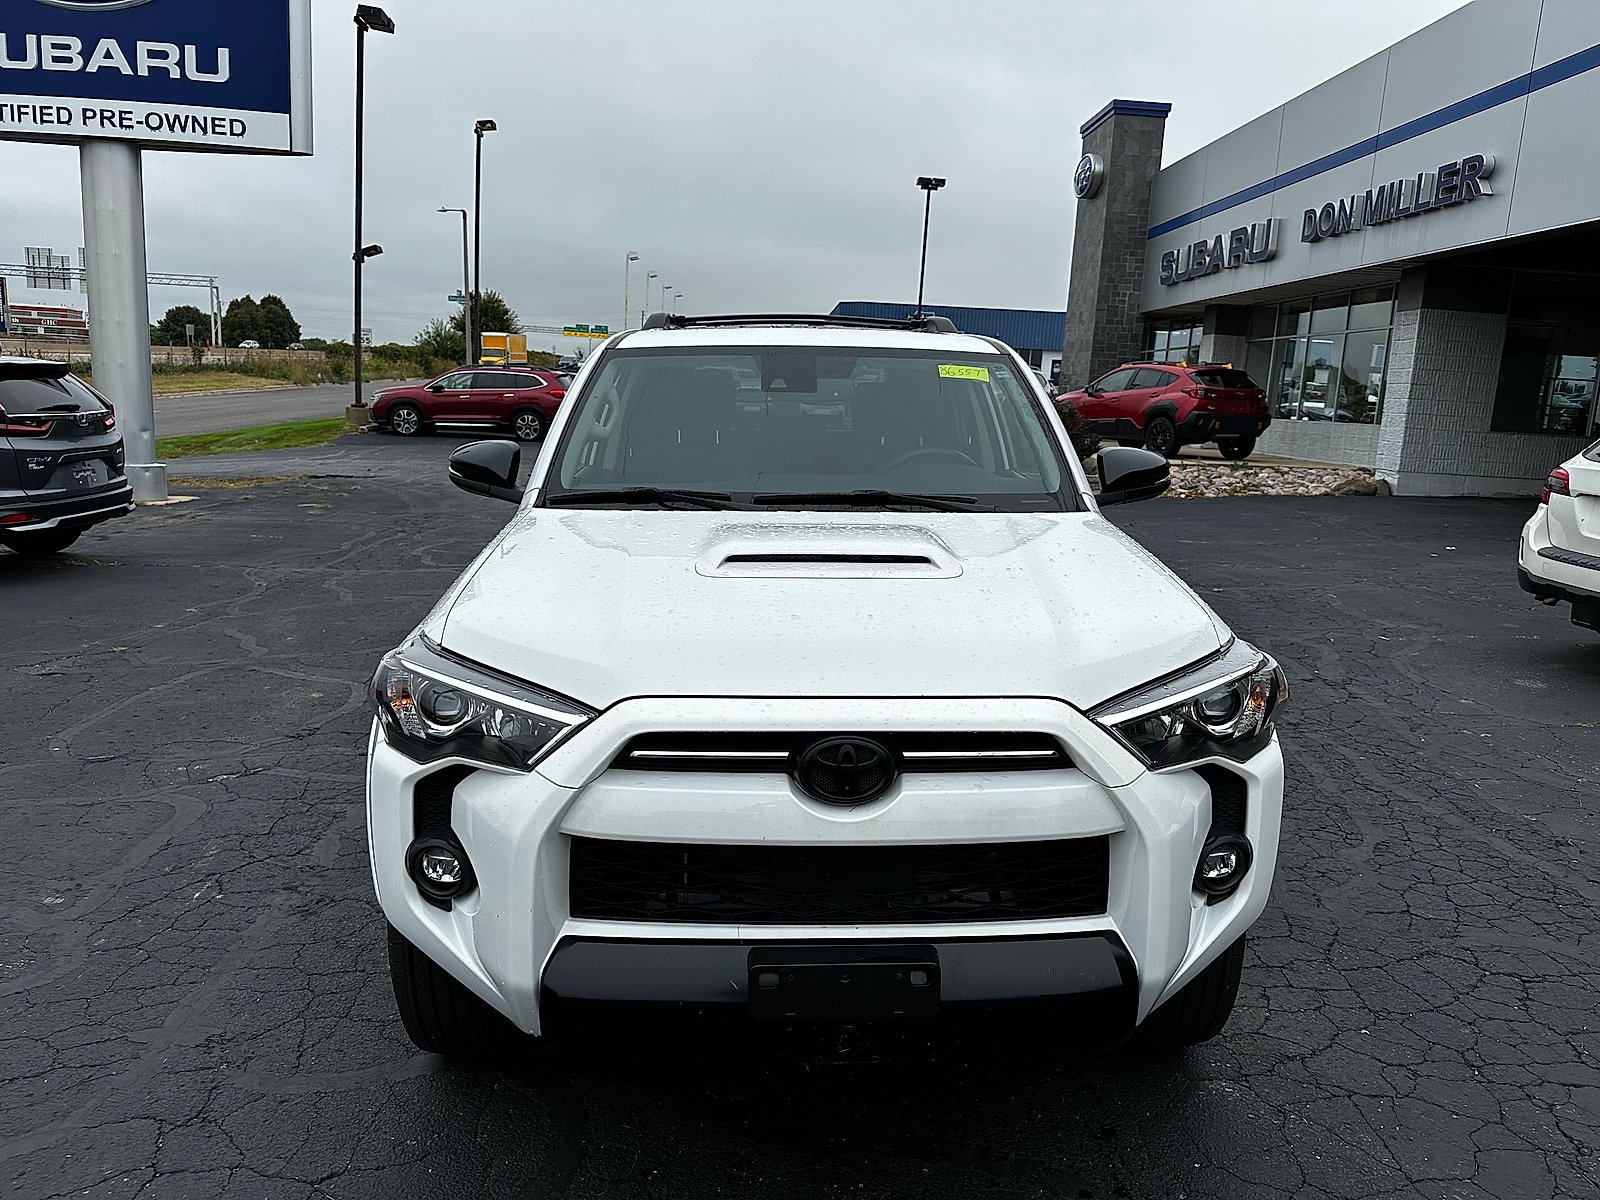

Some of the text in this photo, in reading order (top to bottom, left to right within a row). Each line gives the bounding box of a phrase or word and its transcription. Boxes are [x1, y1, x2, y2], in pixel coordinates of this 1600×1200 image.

[82, 107, 247, 138] PRE-OWNED
[1300, 153, 1496, 243] DON MILLER
[1159, 217, 1281, 287] SUBARU
